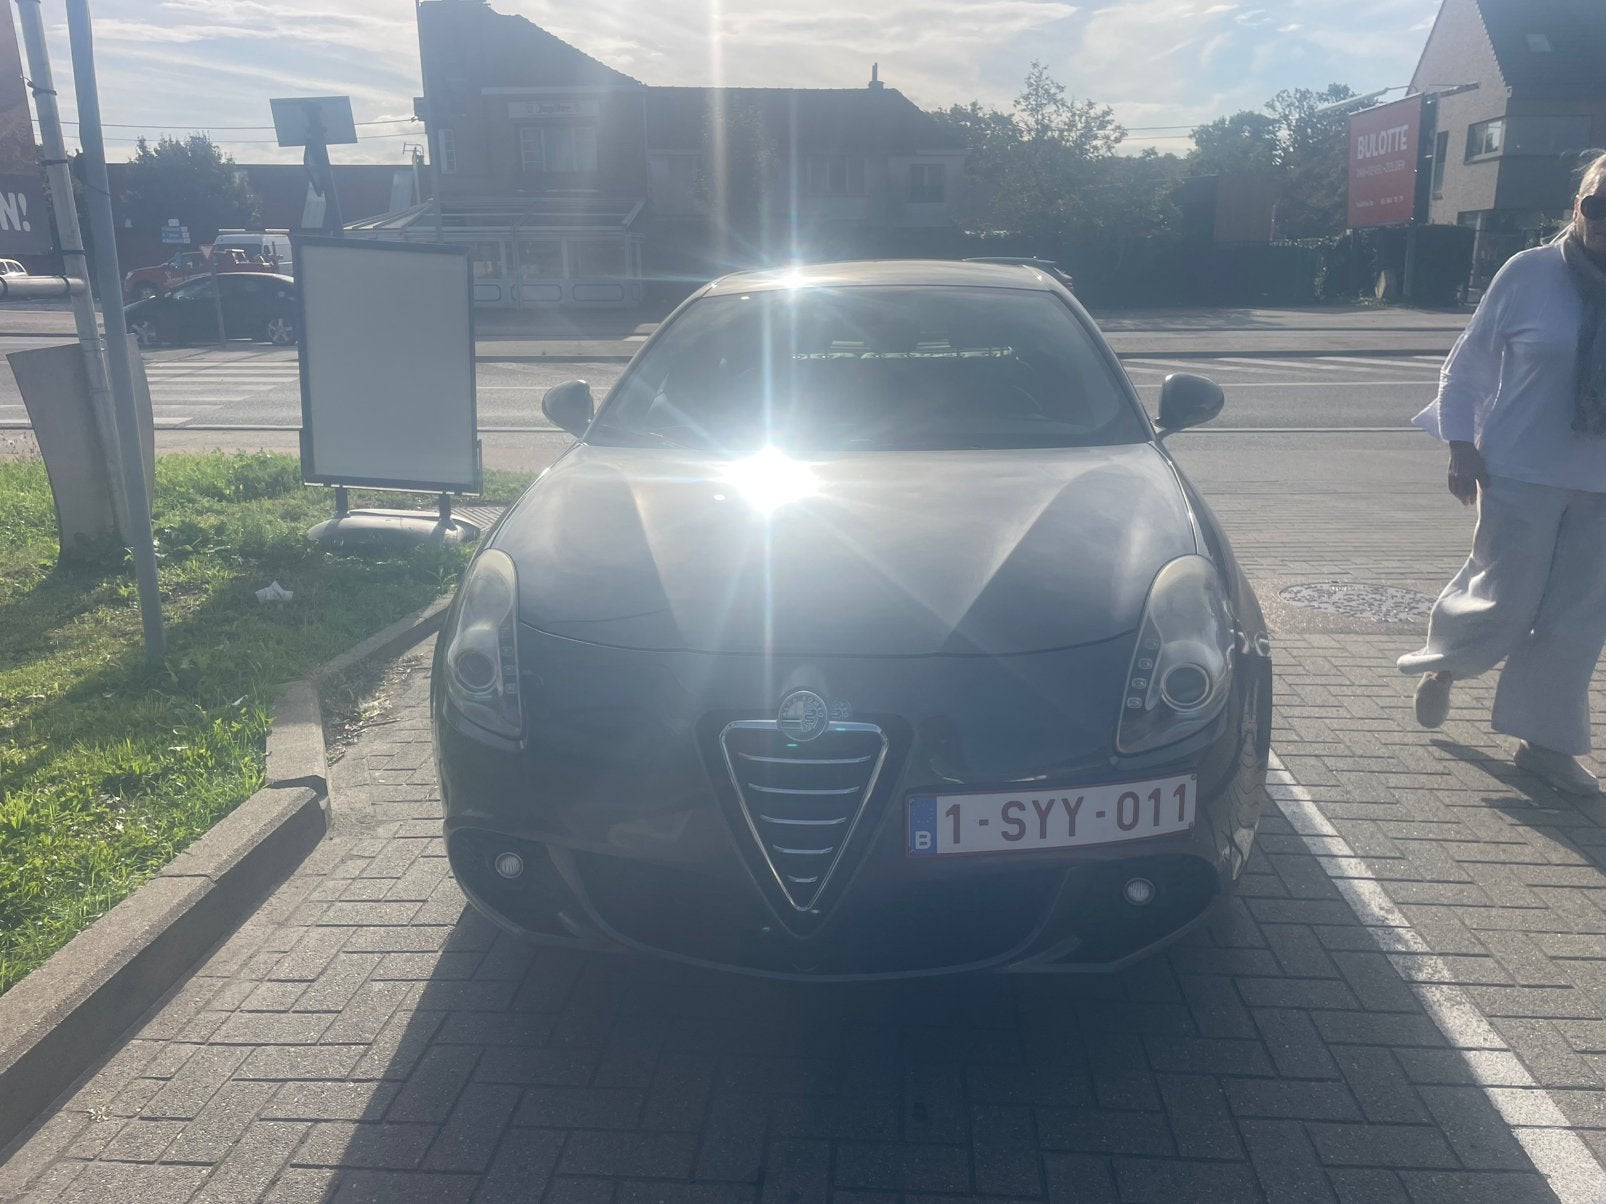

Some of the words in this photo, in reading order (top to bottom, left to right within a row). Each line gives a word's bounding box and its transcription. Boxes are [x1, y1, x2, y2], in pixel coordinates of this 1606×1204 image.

[1357, 124, 1409, 159] BULOTTE
[0, 191, 31, 232] N!
[915, 831, 932, 850] B
